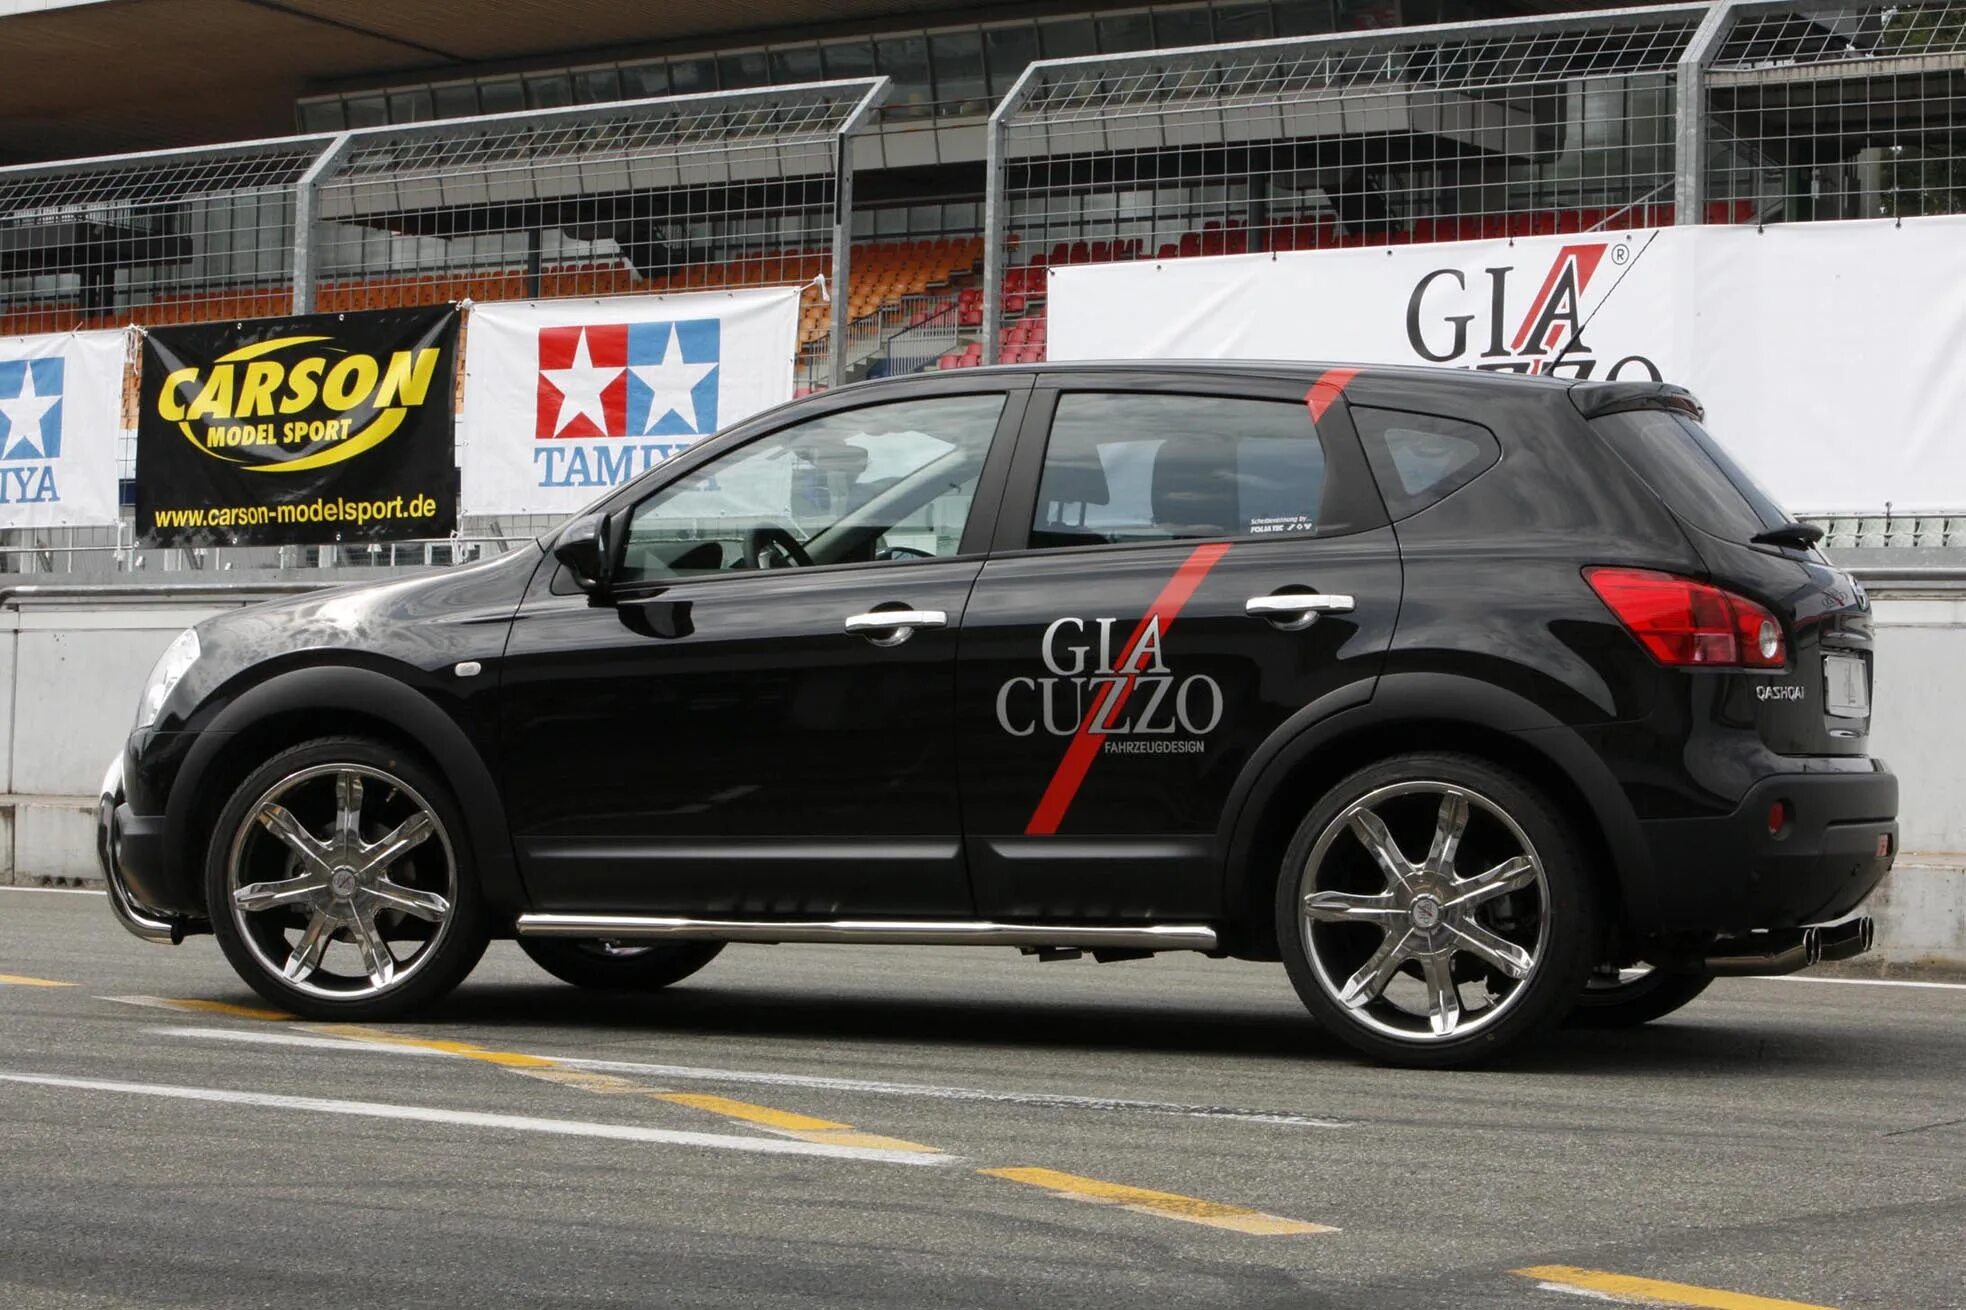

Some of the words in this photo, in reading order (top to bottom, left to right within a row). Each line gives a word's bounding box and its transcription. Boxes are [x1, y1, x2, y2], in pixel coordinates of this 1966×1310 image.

[1406, 259, 1592, 362] GIA
[158, 347, 440, 422] CARSON
[207, 425, 277, 448] MODEL
[283, 418, 352, 444] SPORT
[534, 444, 720, 490] TAMI
[155, 493, 436, 528] www.carson-modelsport.de
[1042, 614, 1171, 675] GIA
[996, 674, 1224, 737] CUZZO
[1756, 686, 1805, 701] QASHQAI
[1104, 740, 1205, 754] FAHRZEUGDESIGN
